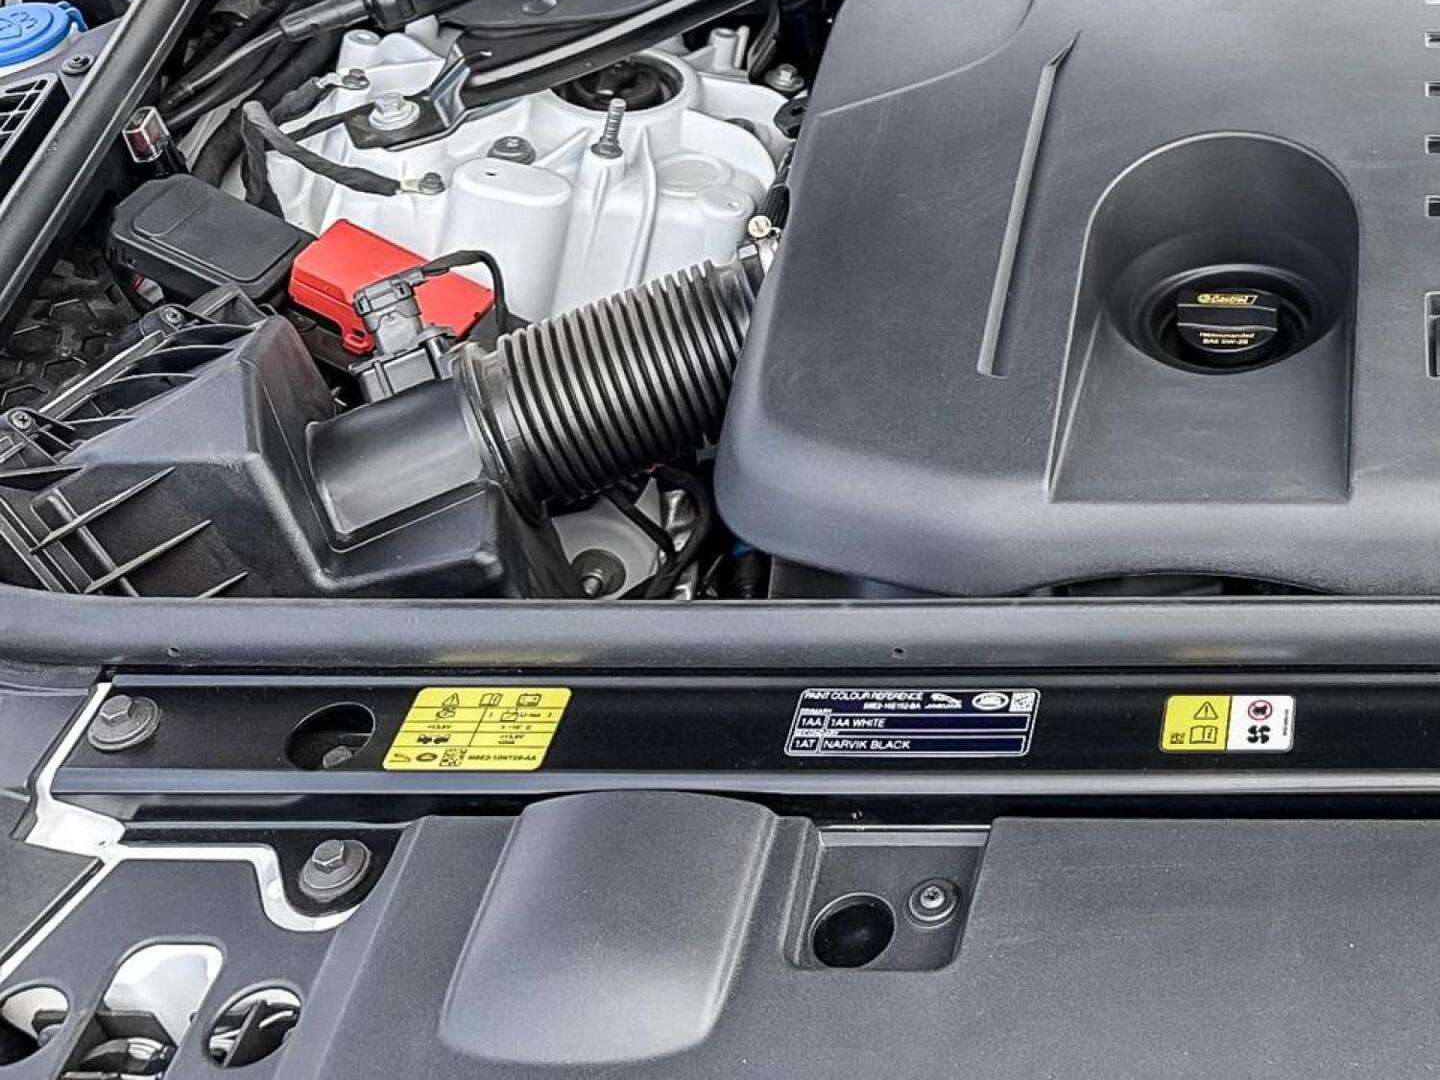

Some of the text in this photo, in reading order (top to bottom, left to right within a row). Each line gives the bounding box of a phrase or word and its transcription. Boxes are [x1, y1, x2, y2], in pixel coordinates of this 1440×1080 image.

[803, 692, 924, 701] PAINT COLOUR REFERENCE
[802, 718, 822, 727] 1AA
[831, 718, 887, 728] 1AA WHITE
[795, 740, 816, 748] 1AT
[823, 740, 912, 750] NARVIK BLACK
